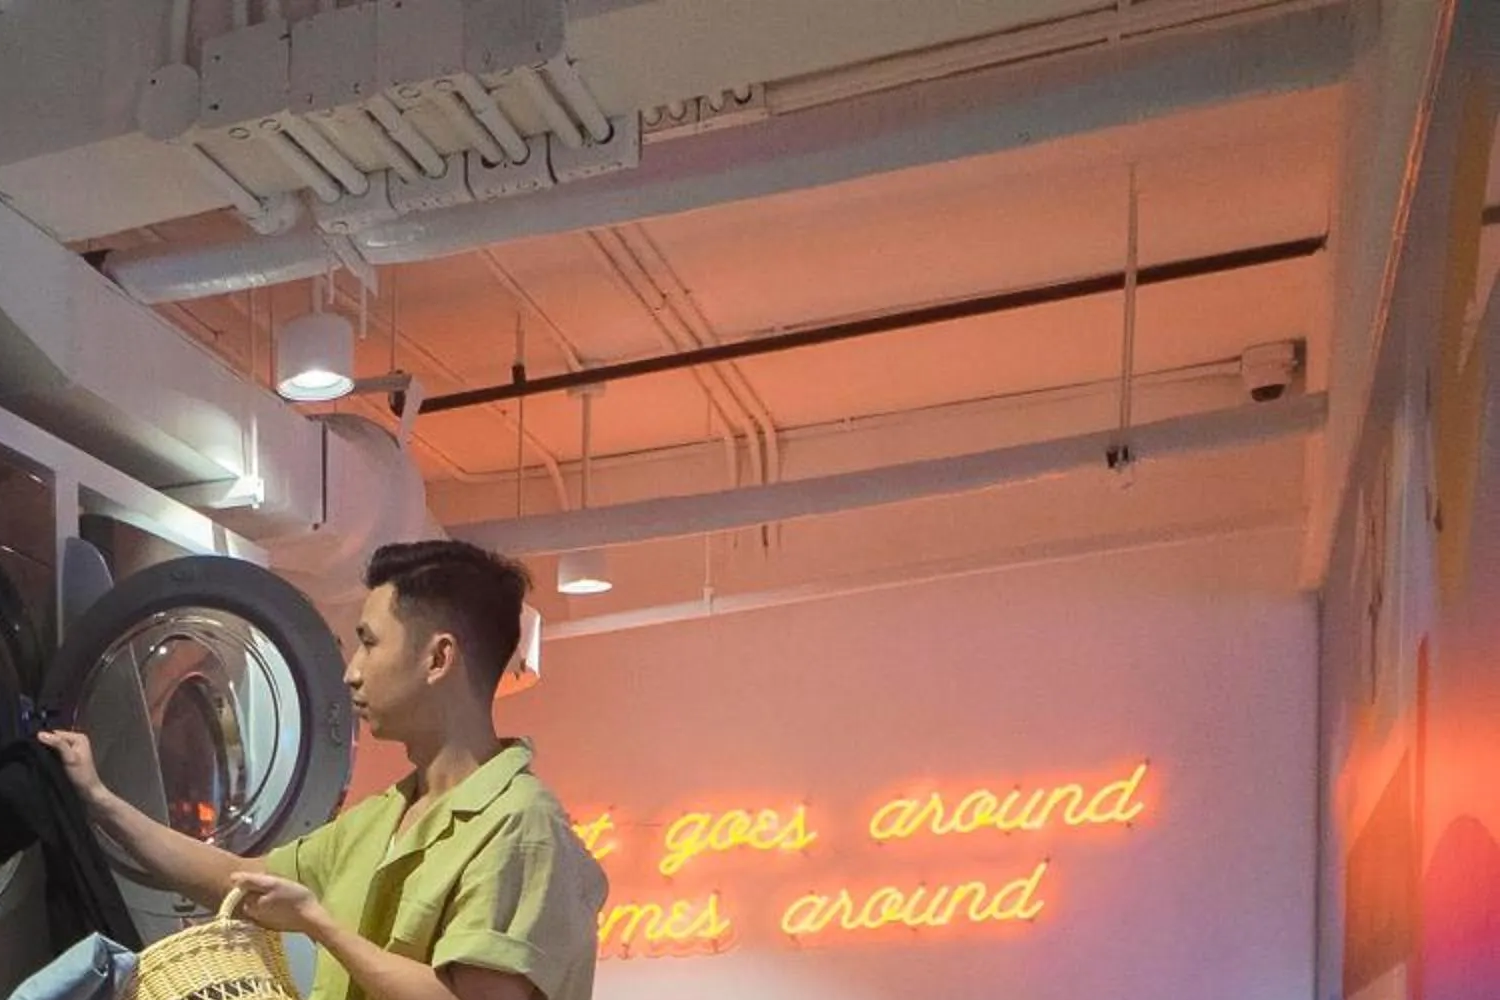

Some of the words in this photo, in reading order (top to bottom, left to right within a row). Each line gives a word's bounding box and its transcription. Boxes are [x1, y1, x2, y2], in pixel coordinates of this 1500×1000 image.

[658, 804, 818, 876] goes
[869, 763, 1147, 840] around
[597, 893, 731, 942] mes
[781, 862, 1048, 934] around
